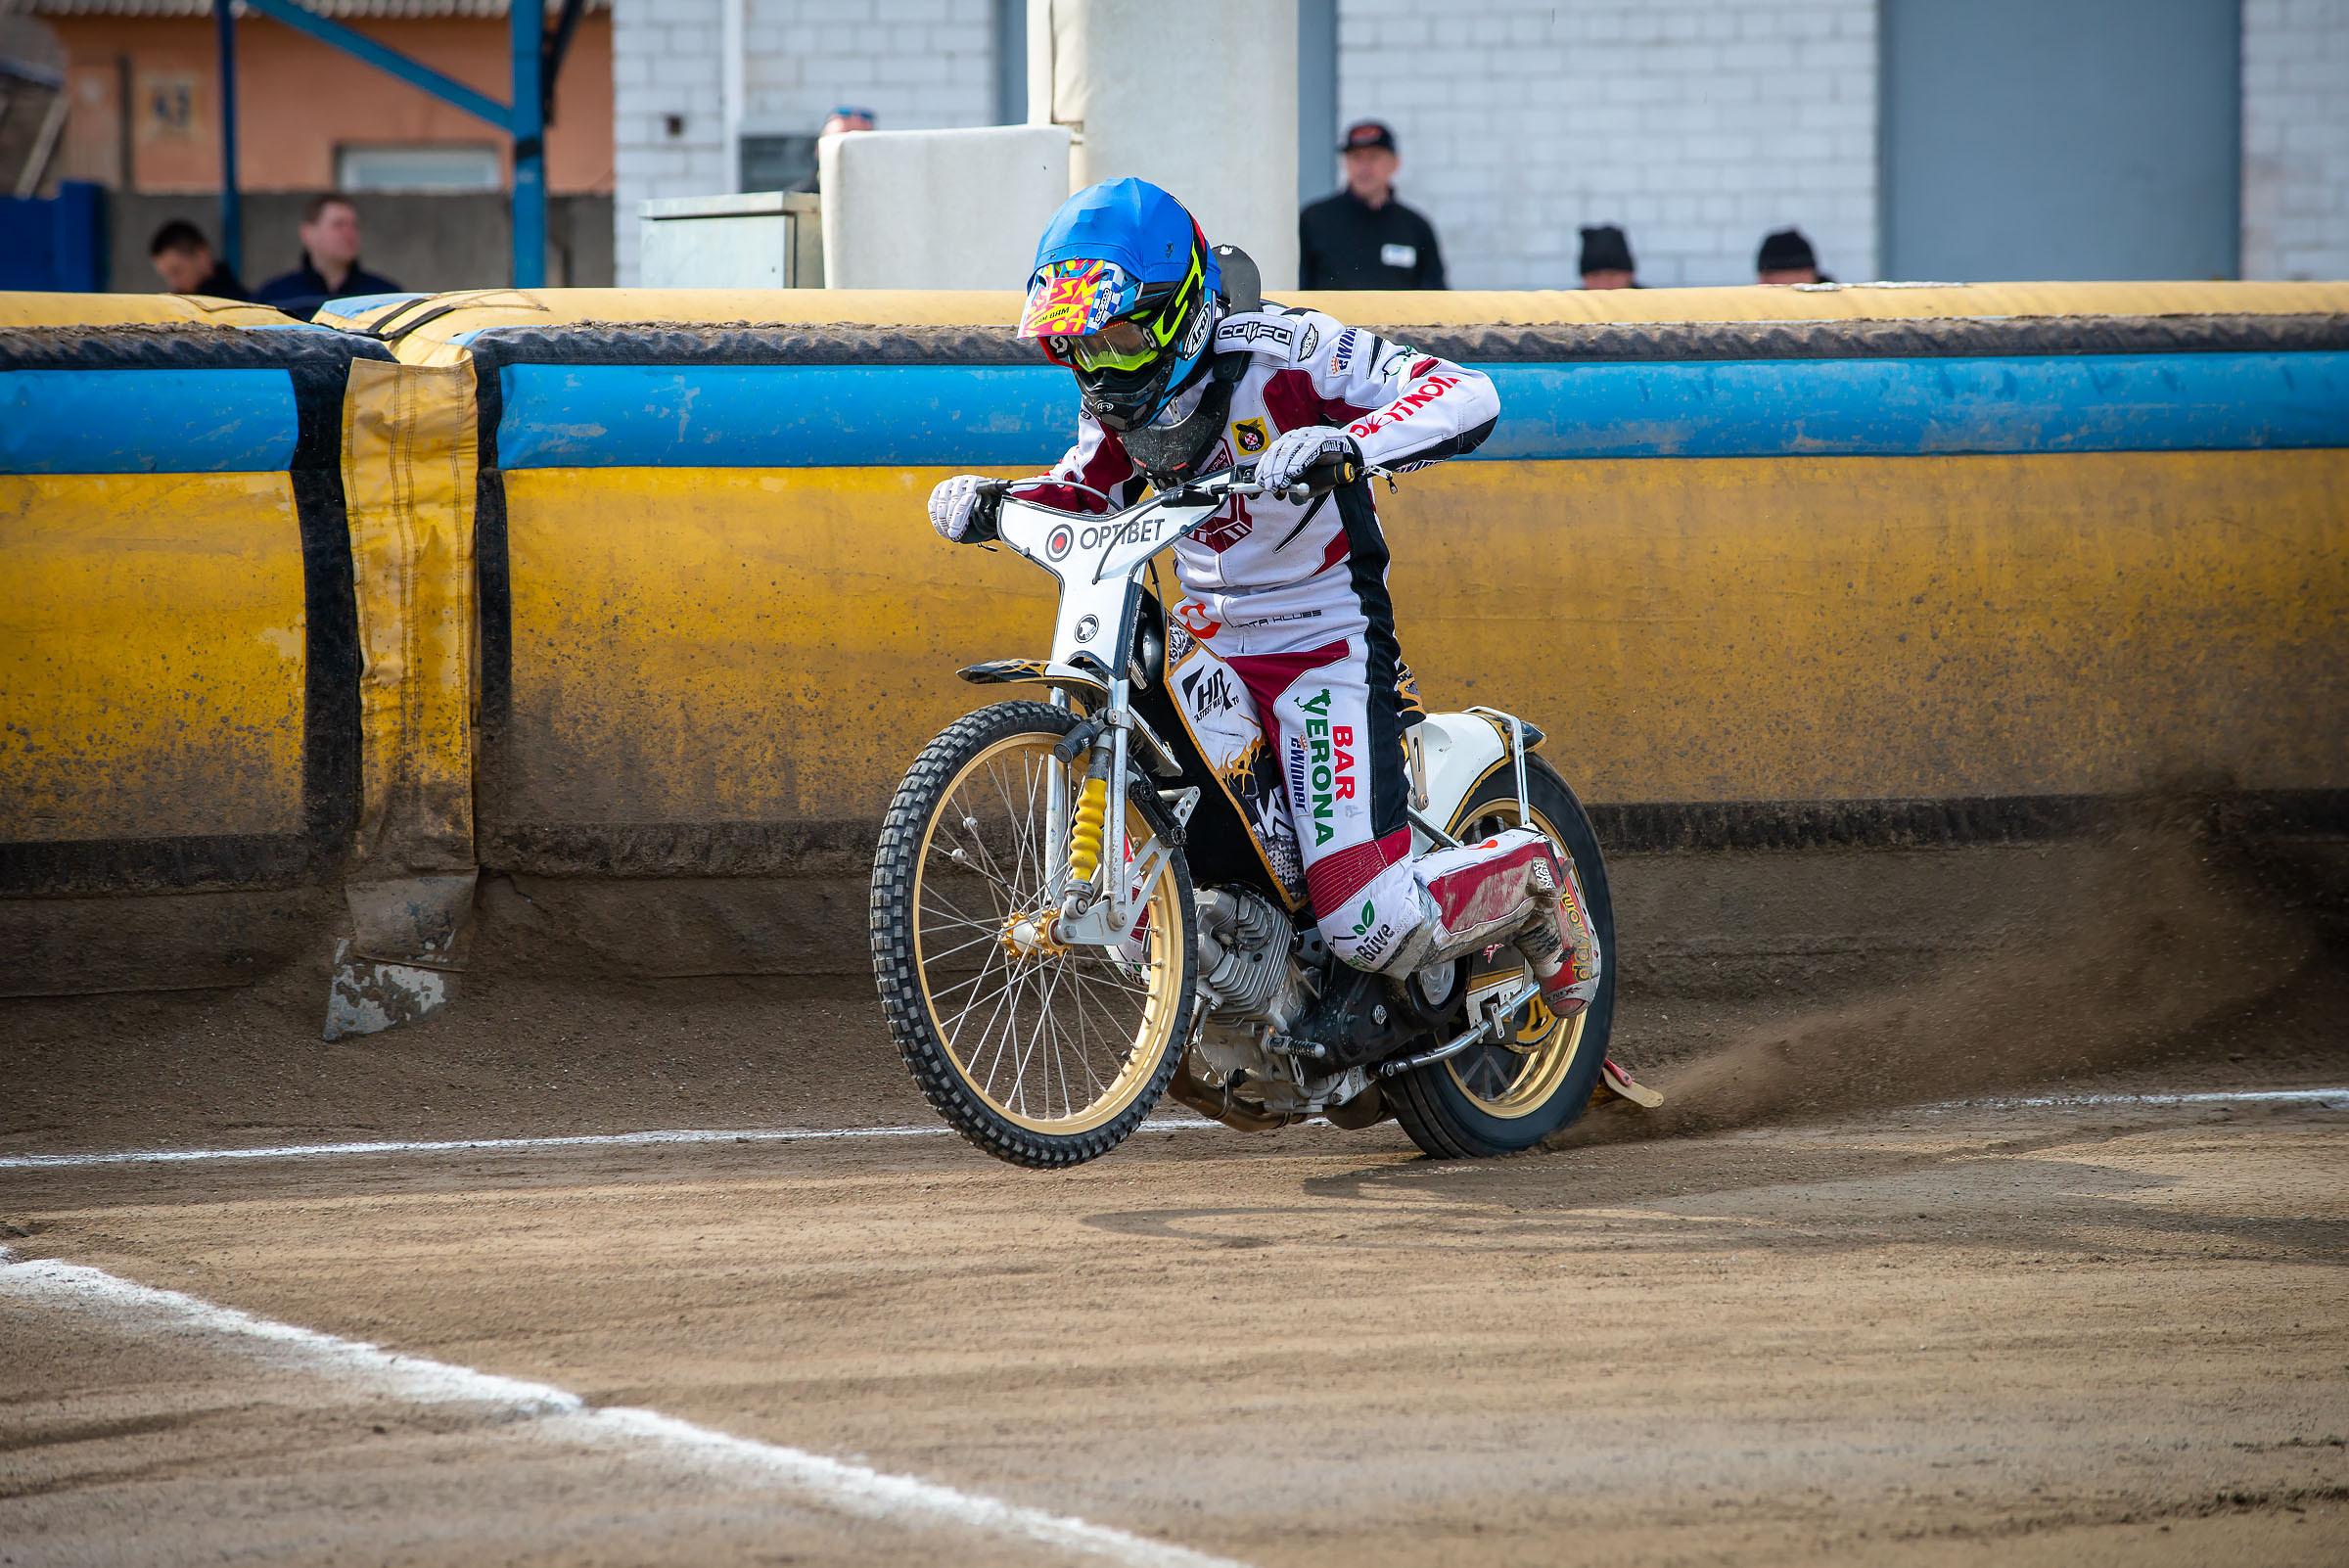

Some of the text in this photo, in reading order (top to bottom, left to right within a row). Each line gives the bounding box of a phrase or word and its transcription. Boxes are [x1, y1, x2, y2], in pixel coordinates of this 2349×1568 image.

[1080, 518, 1166, 550] OPTIBET
[1272, 609, 1322, 623] KLUBS
[1293, 688, 1334, 848] VERONA
[1332, 725, 1355, 802] BAR
